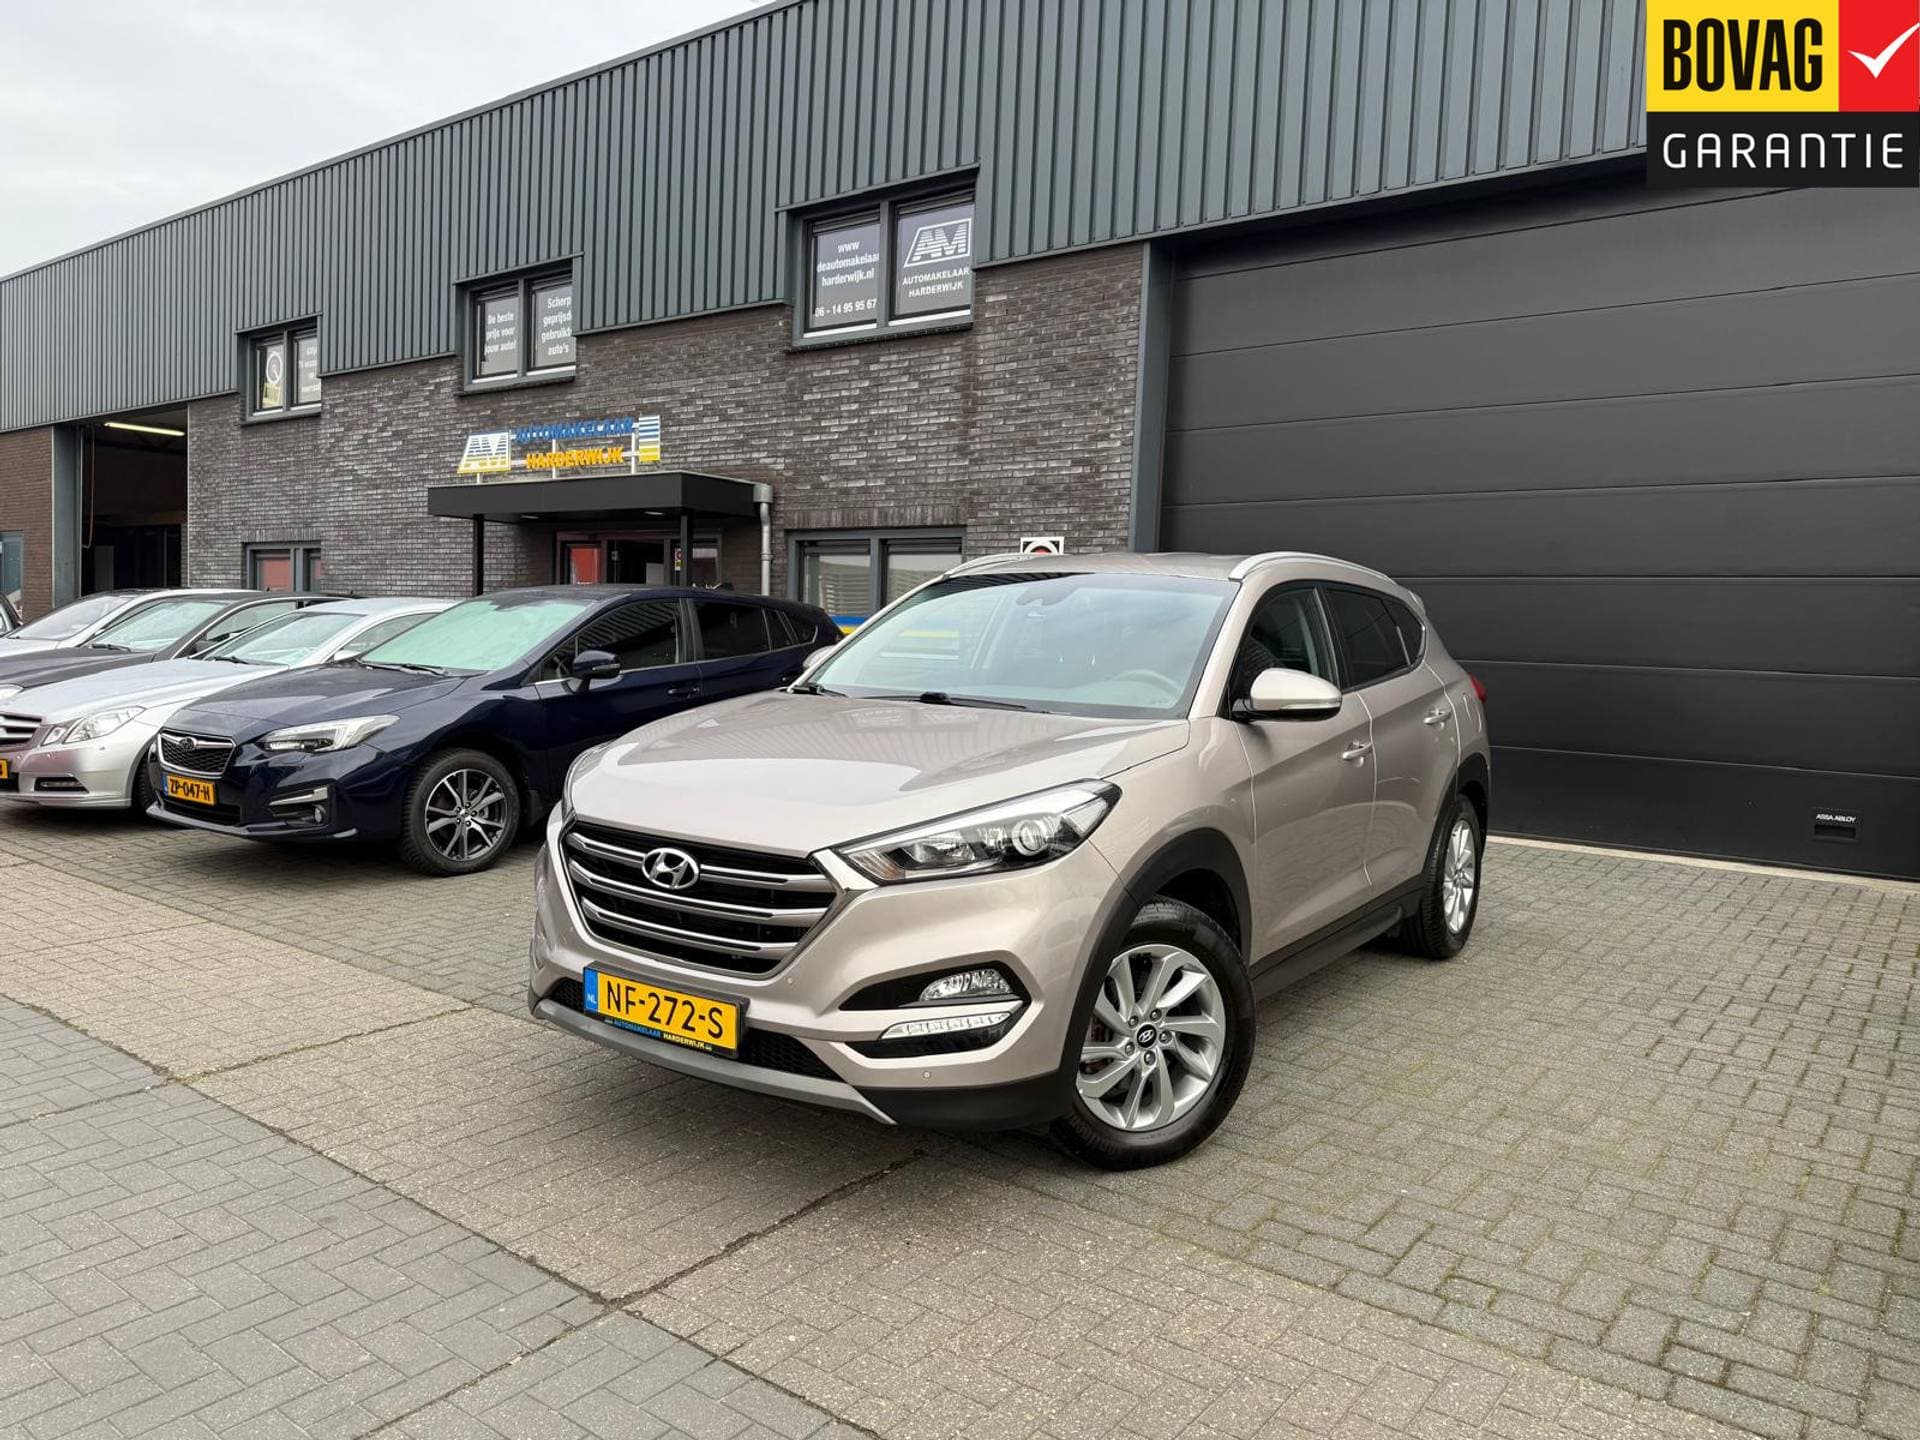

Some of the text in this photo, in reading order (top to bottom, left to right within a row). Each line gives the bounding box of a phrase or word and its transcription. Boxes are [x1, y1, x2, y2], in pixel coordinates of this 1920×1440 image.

[837, 241, 860, 253] www
[821, 267, 875, 287] harderwijk.nl
[902, 266, 970, 285] AUTOMAKELAAR
[908, 281, 963, 298] HARDERWIJK
[547, 296, 572, 309] Scherp
[832, 303, 842, 315] 14
[843, 302, 853, 314] 95
[855, 300, 865, 312] 95
[866, 298, 877, 310] 67
[543, 310, 572, 328] geprijsd
[515, 416, 634, 445] AUTOMAKELAAR
[526, 445, 624, 470] HARDERWIJK
[168, 777, 211, 802] ZP-047-H
[1834, 815, 1857, 823] ABLOY
[586, 980, 724, 1040] NL NF-272-S
[613, 1019, 705, 1049] AUTOMAKELAAR HARDERWIJK
